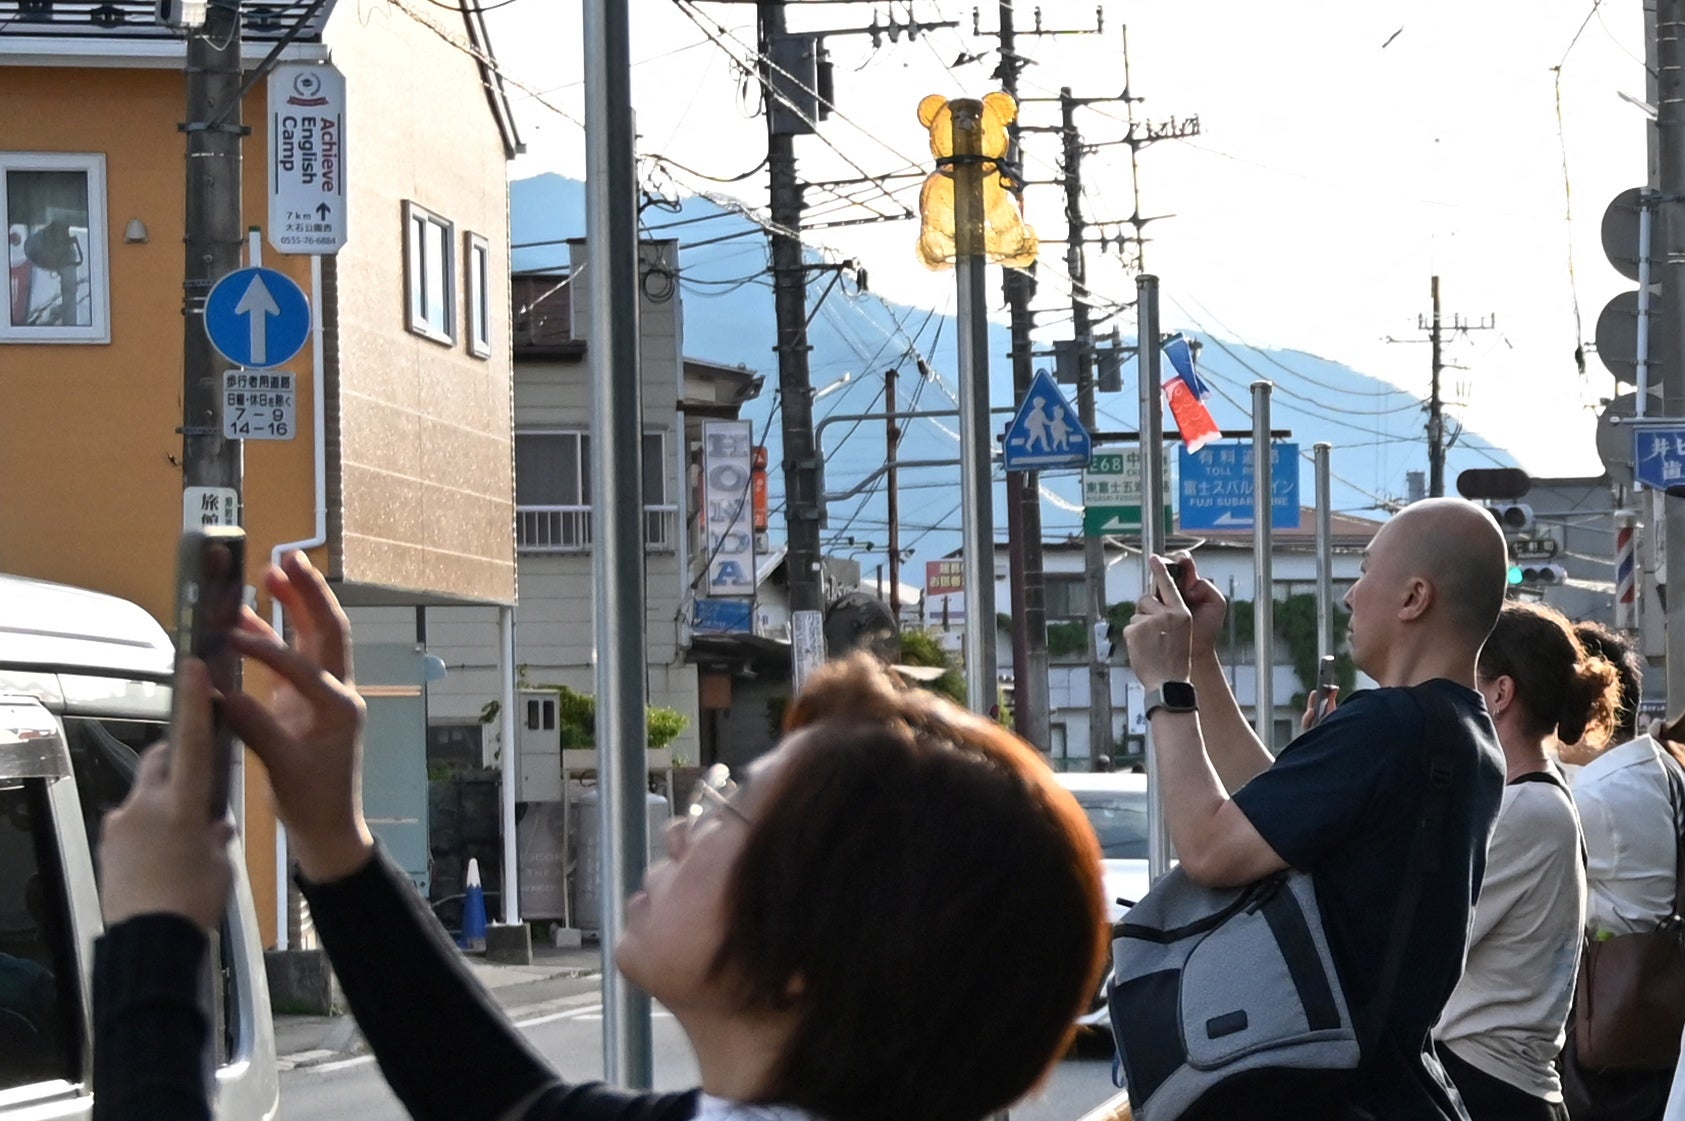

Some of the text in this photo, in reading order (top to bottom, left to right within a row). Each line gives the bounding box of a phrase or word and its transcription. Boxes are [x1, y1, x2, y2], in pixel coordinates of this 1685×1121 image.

[280, 116, 297, 171] Camp
[298, 116, 317, 184] English
[320, 117, 337, 192] Achieve
[708, 433, 753, 587] HONDA
[1184, 480, 1294, 496] 富士スバルイン
